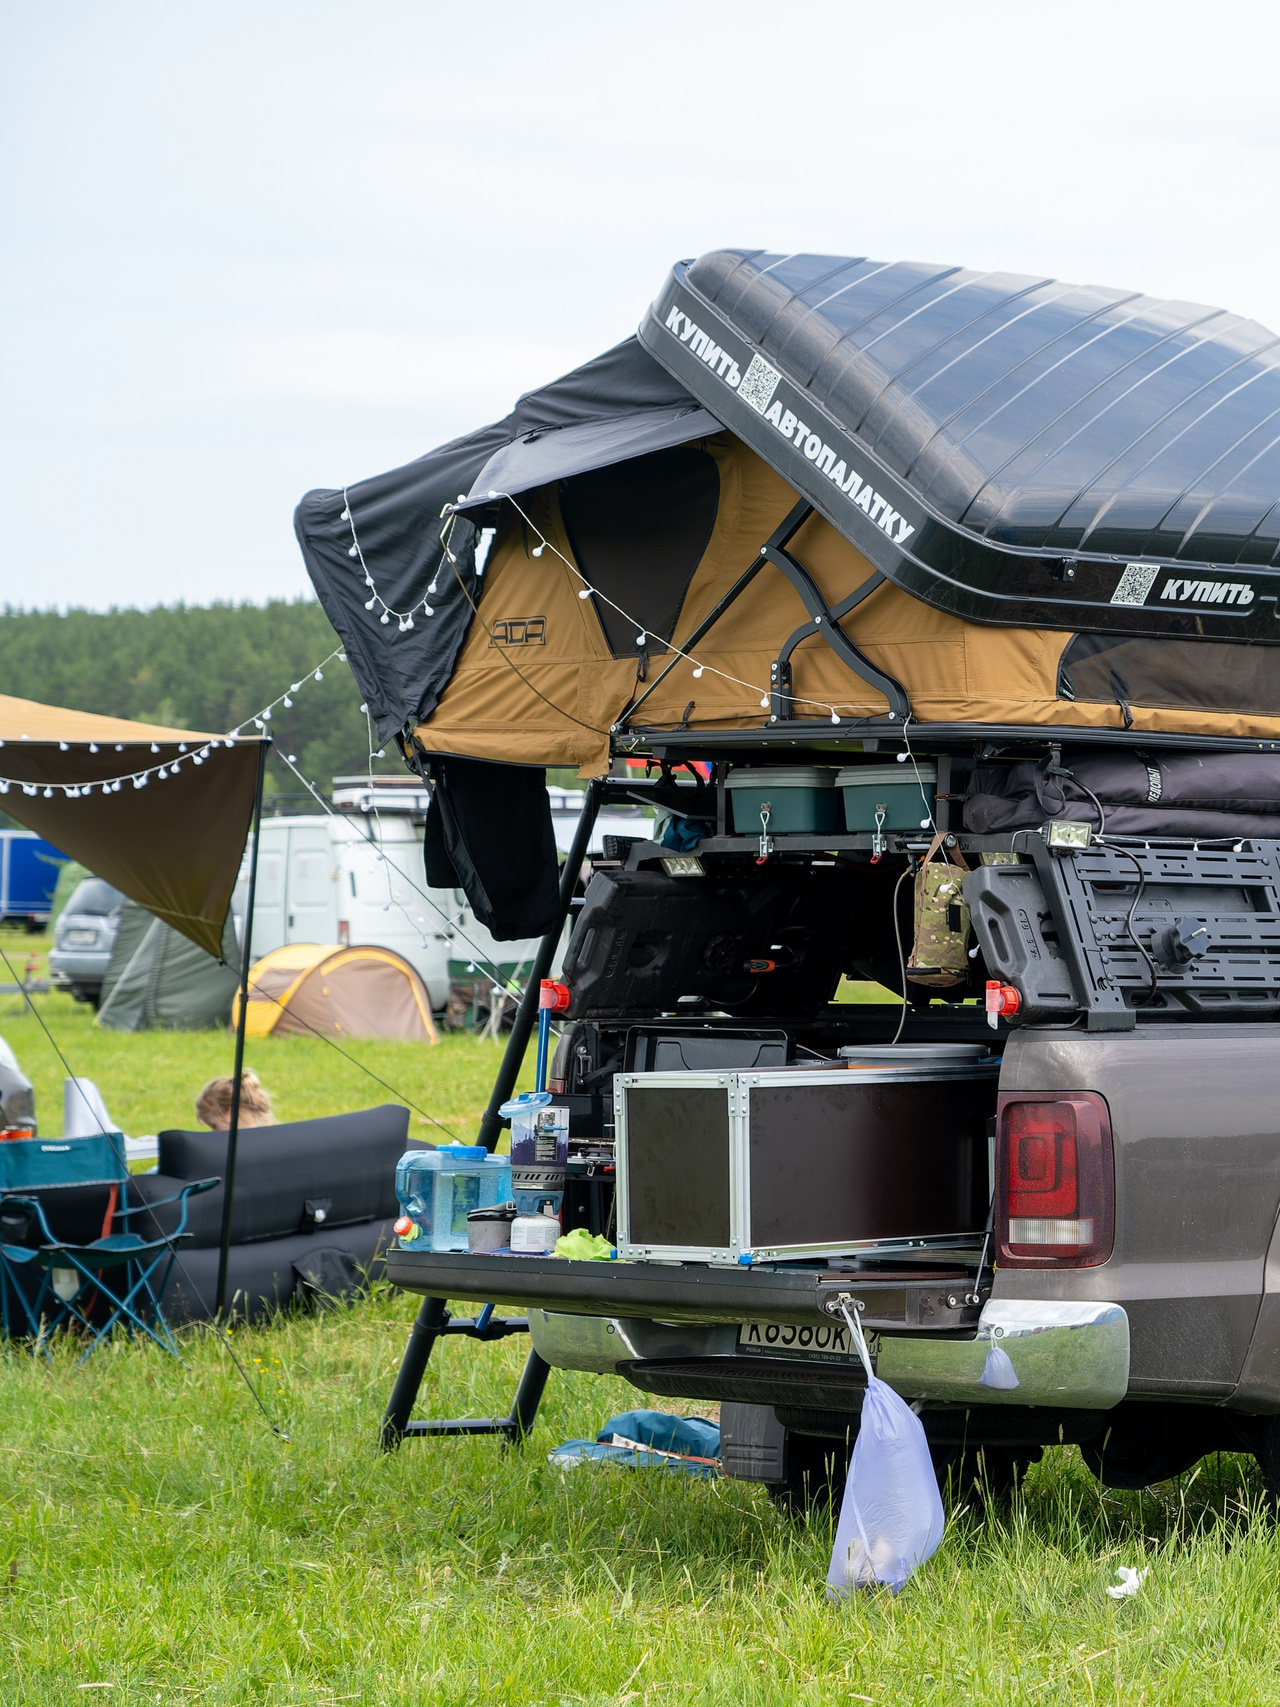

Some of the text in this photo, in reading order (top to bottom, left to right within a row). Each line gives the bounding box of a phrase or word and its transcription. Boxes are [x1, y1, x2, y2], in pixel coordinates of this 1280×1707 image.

[664, 305, 915, 544] КУПИТЬ АВТОПАЛАТКУ
[1160, 579, 1254, 605] КУПИТЬ
[1147, 767, 1162, 802] ЛЕДОПЫТ
